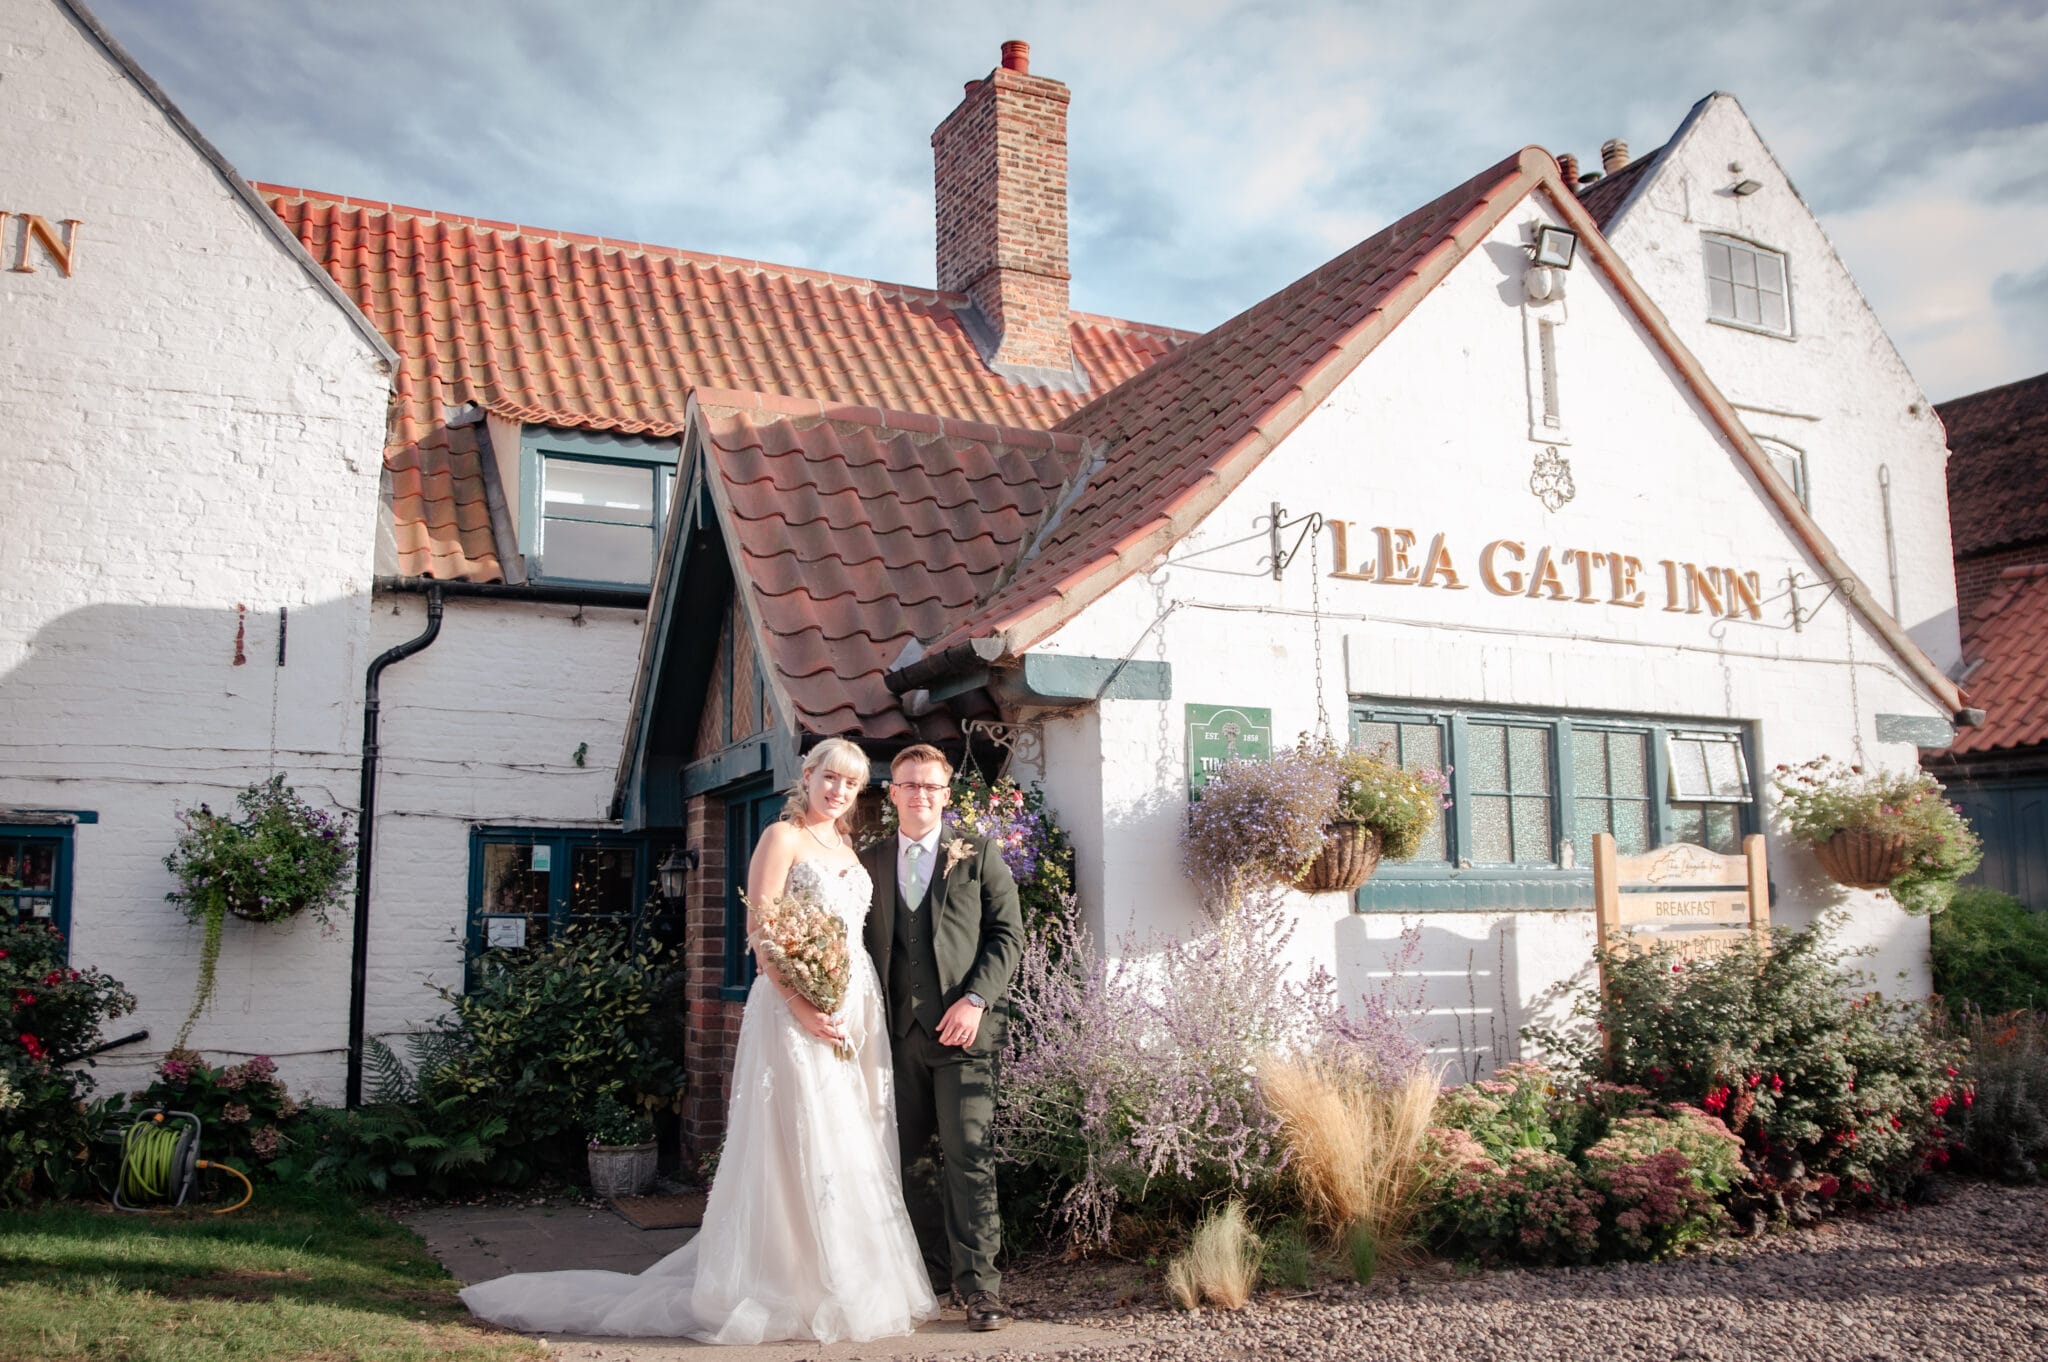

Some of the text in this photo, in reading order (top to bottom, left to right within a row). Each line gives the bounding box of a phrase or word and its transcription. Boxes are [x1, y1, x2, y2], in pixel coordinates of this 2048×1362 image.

[0, 211, 85, 279] N
[1325, 518, 1763, 621] LEA GATE INN
[1656, 901, 1717, 916] BREAKFAST
